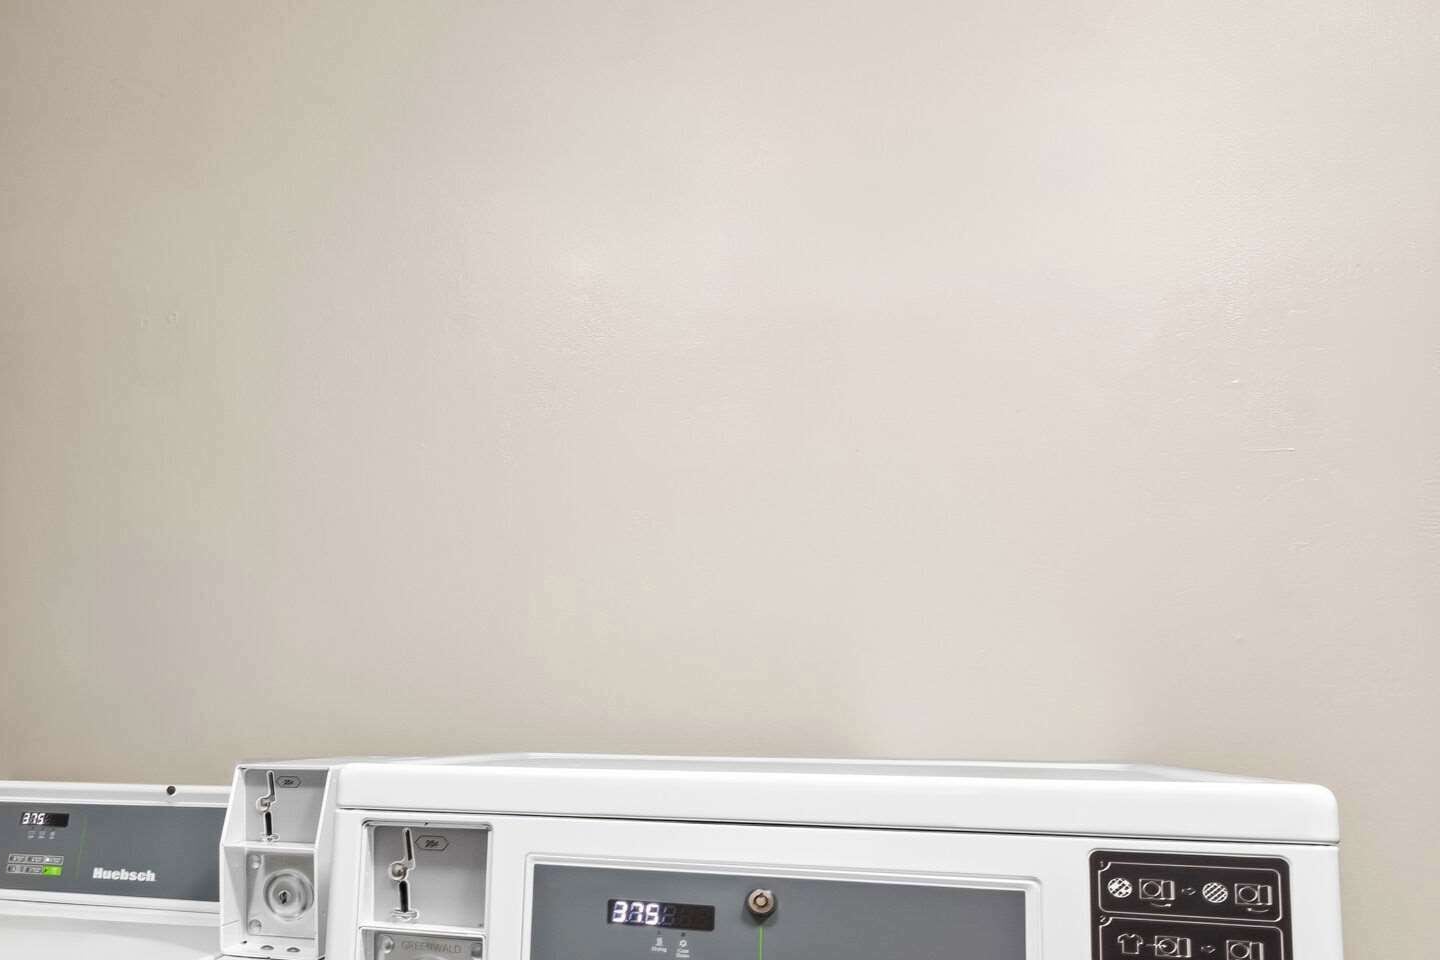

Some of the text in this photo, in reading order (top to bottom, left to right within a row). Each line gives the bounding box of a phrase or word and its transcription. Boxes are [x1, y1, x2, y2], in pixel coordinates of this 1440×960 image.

[22, 812, 45, 825] 375
[93, 867, 156, 882] Huebsch
[612, 901, 659, 925] 375
